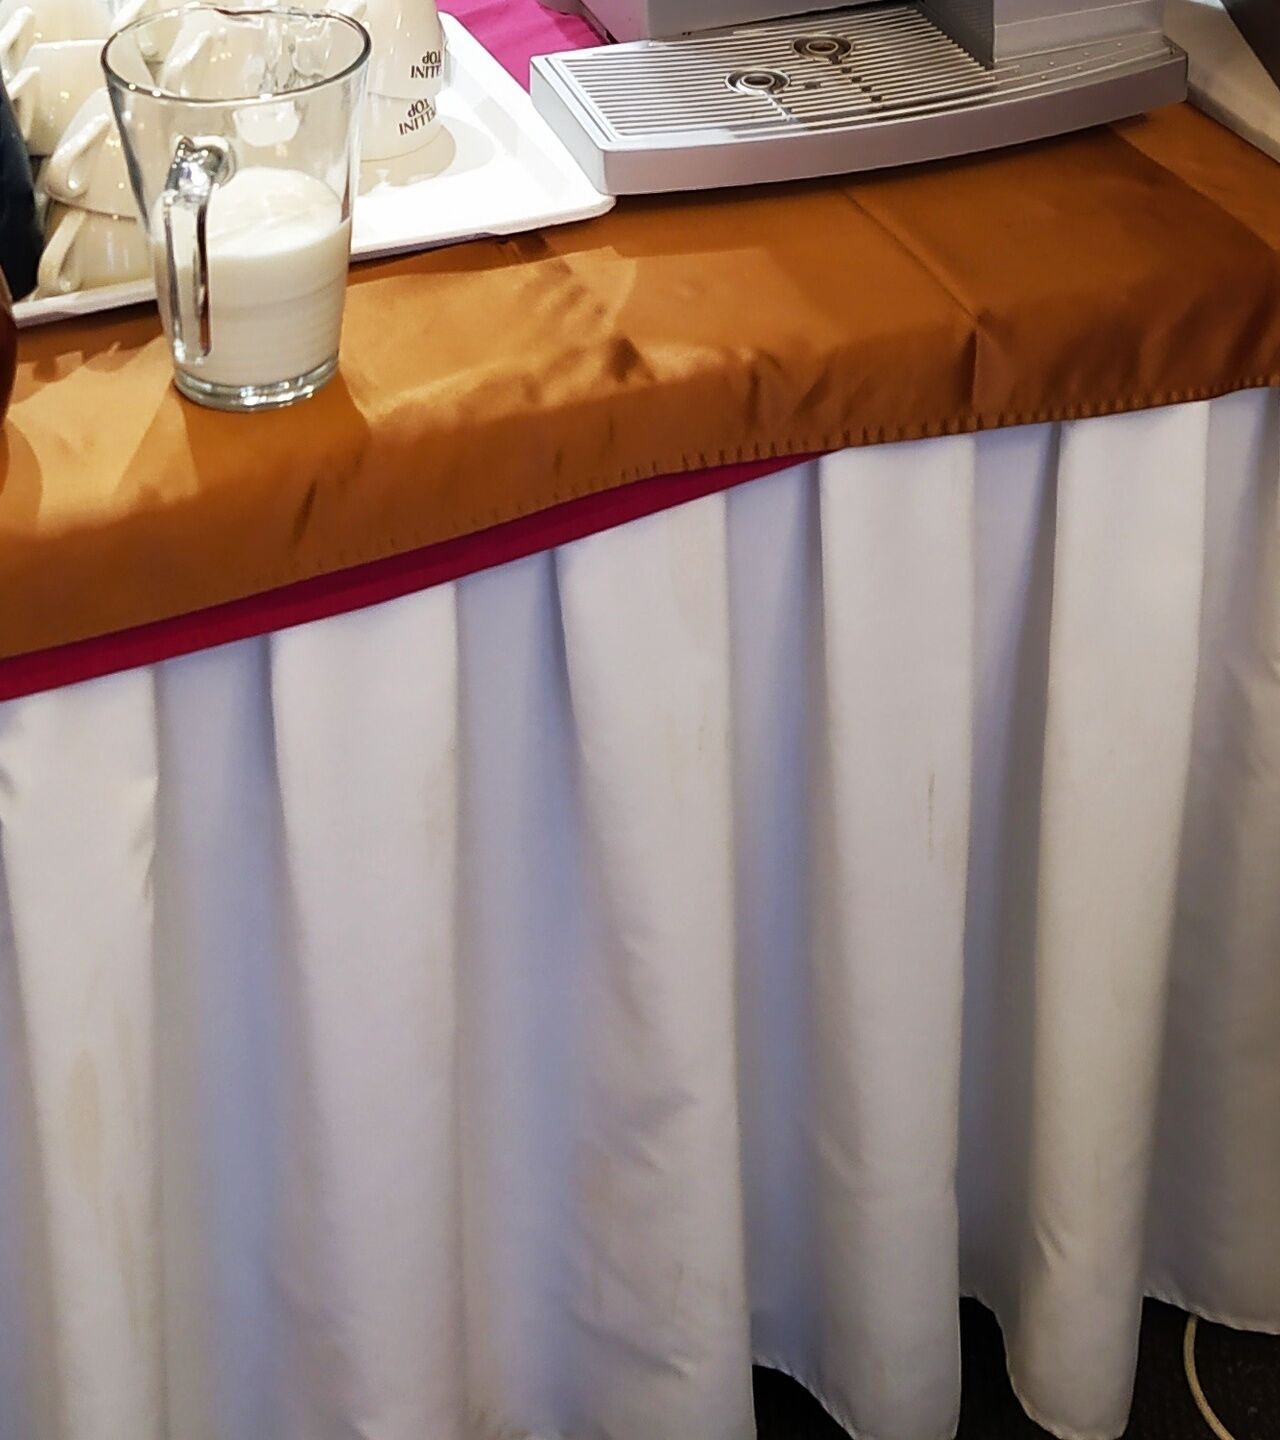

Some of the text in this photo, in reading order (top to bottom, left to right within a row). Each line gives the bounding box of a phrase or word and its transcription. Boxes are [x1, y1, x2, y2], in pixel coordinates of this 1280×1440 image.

[422, 50, 442, 65] TOP
[408, 98, 430, 117] TOP
[399, 108, 437, 135] ELLINI
